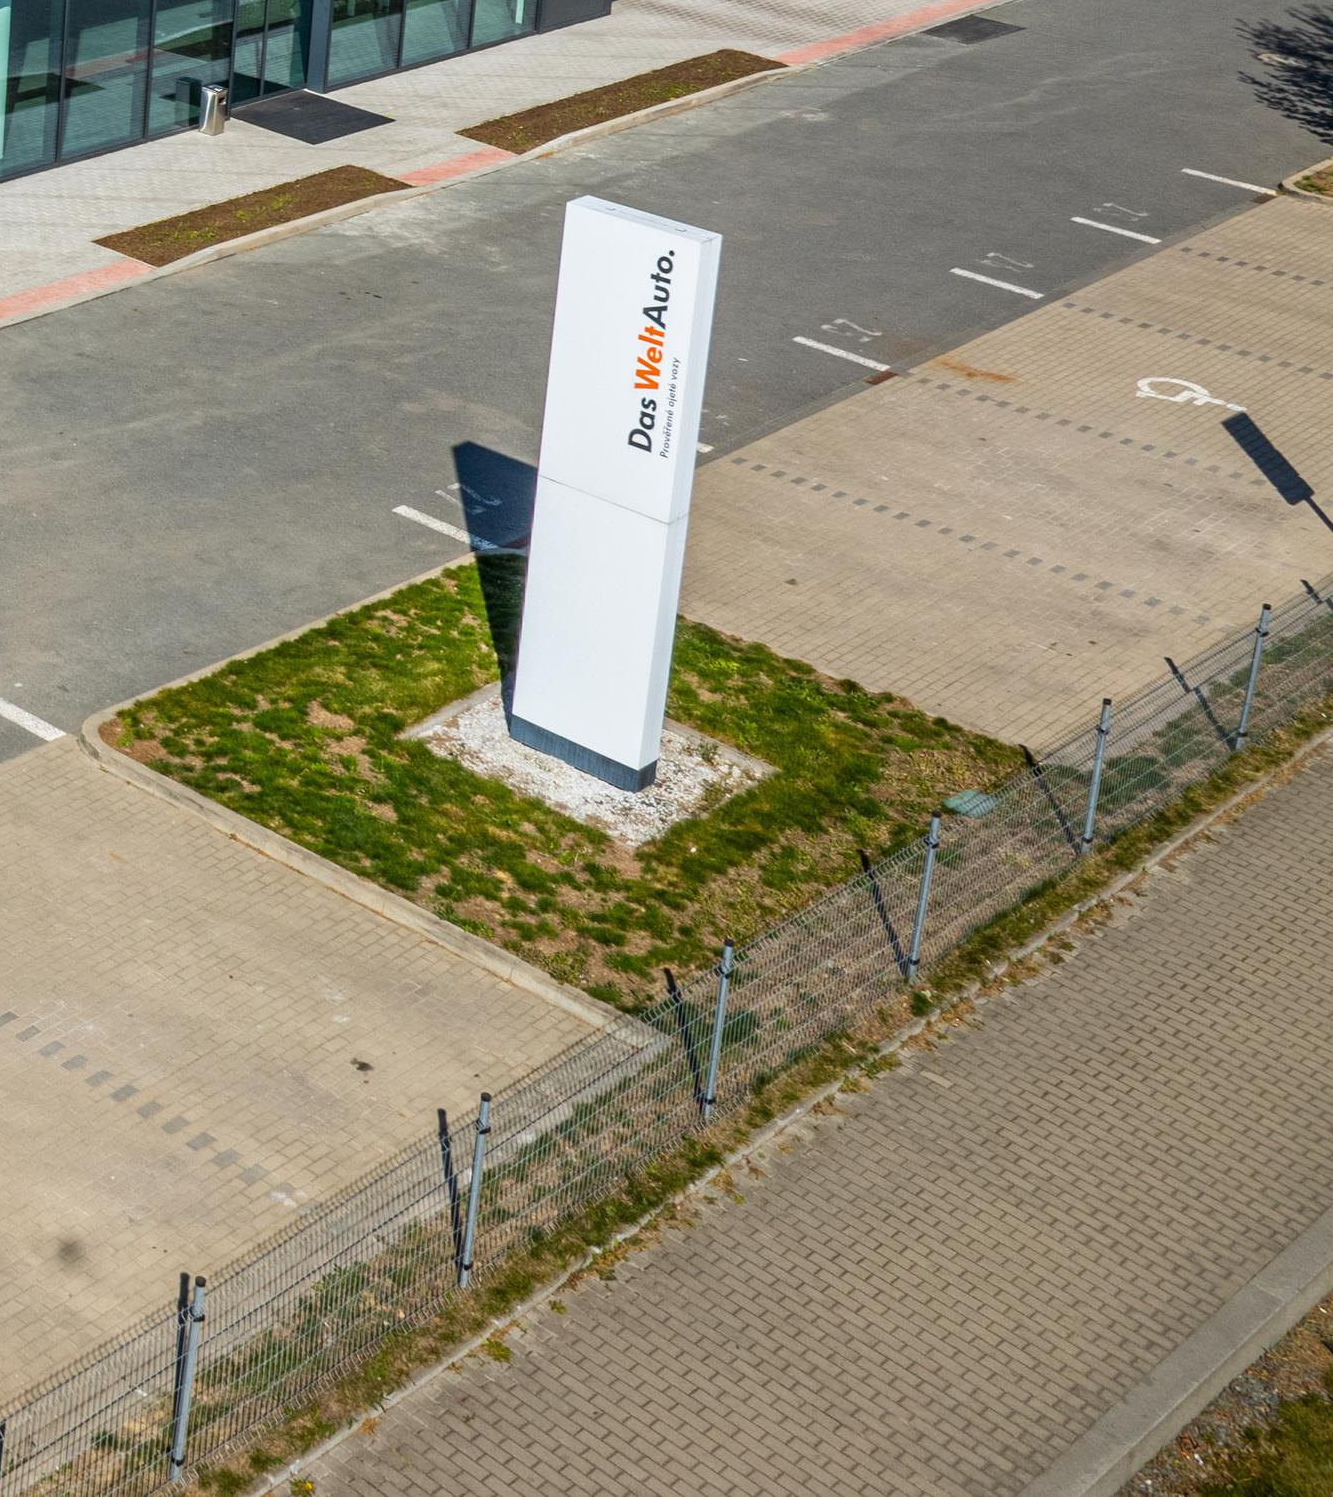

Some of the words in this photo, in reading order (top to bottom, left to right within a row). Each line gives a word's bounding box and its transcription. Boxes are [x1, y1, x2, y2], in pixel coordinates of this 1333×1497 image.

[634, 250, 675, 390] WeltAuto.
[672, 357, 681, 381] vozy
[627, 397, 657, 453] Das
